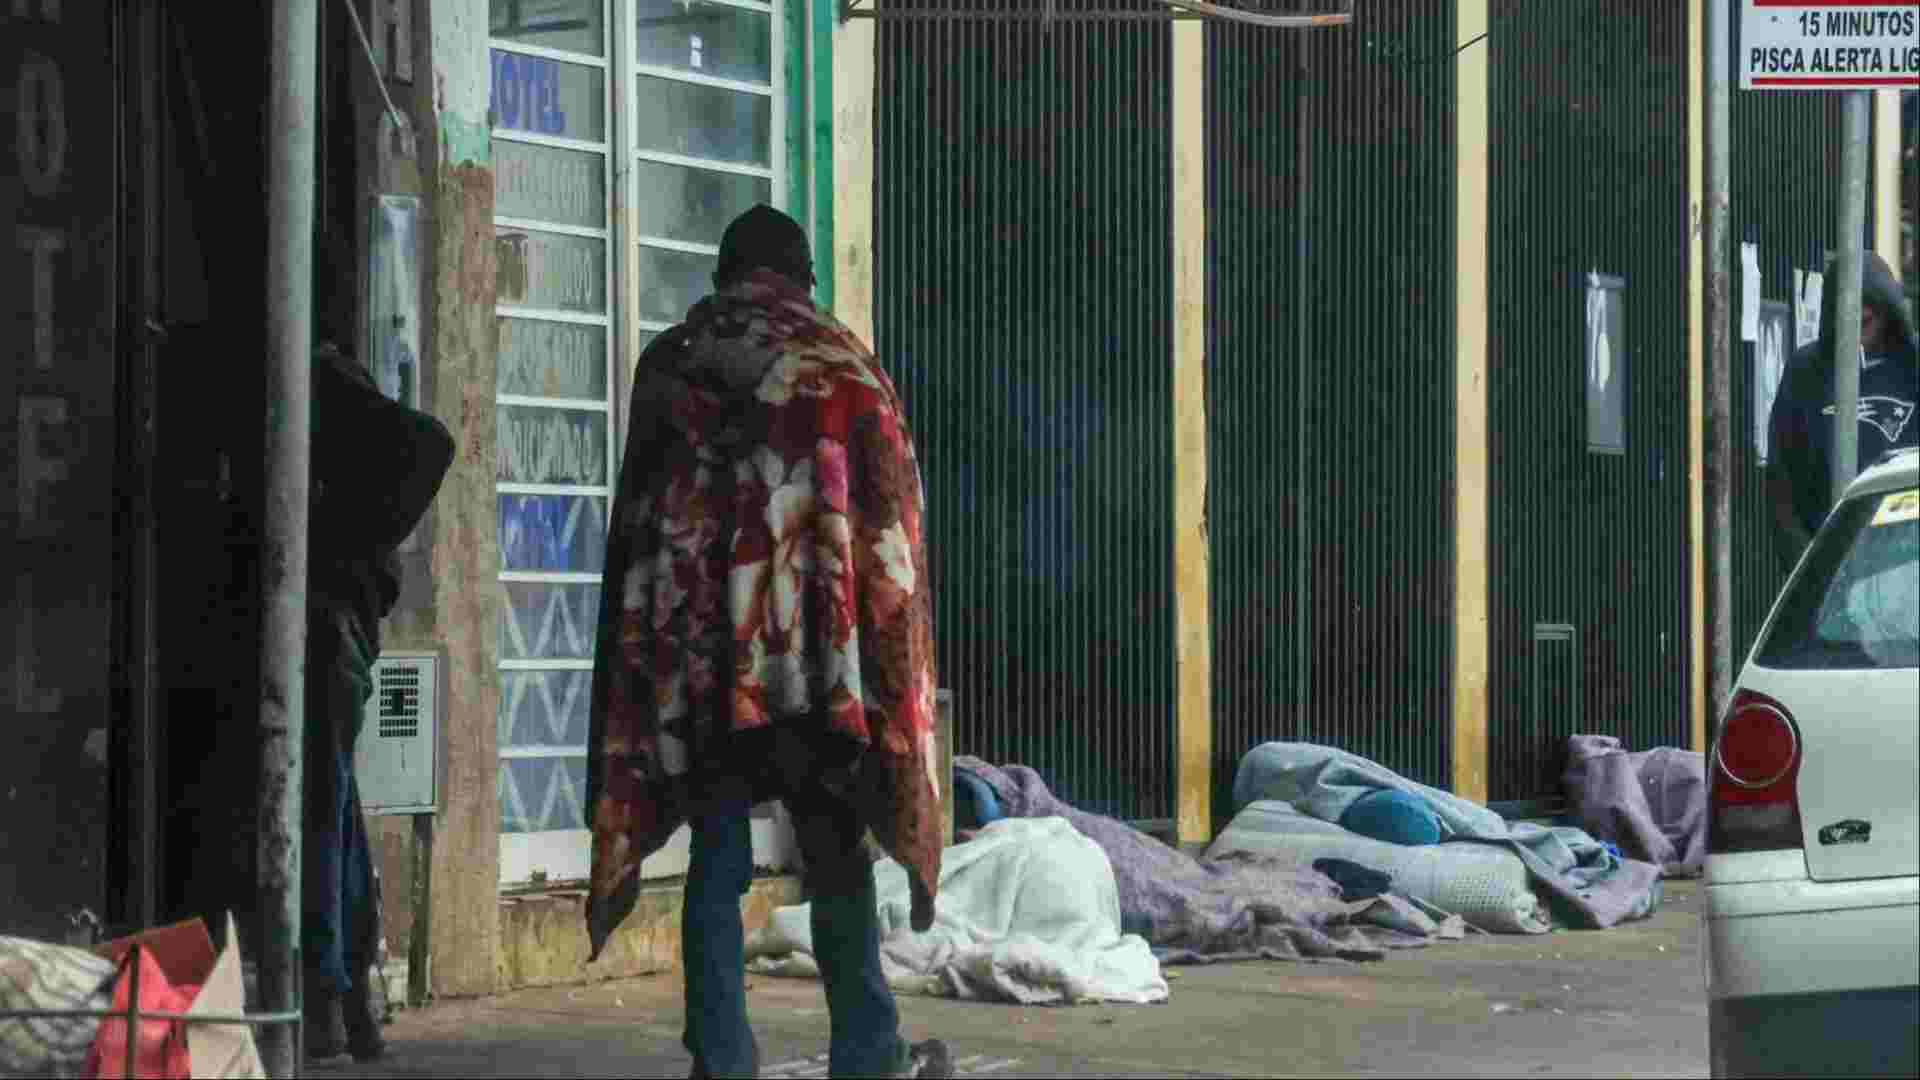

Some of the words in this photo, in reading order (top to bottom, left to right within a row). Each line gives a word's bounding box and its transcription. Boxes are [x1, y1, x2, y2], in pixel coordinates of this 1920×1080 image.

[1800, 11, 1820, 36] 15
[1826, 11, 1914, 36] MINUTOS
[1750, 48, 1805, 72] PISCA
[1811, 48, 1882, 72] ALERTA
[16, 0, 68, 712] OTEL
